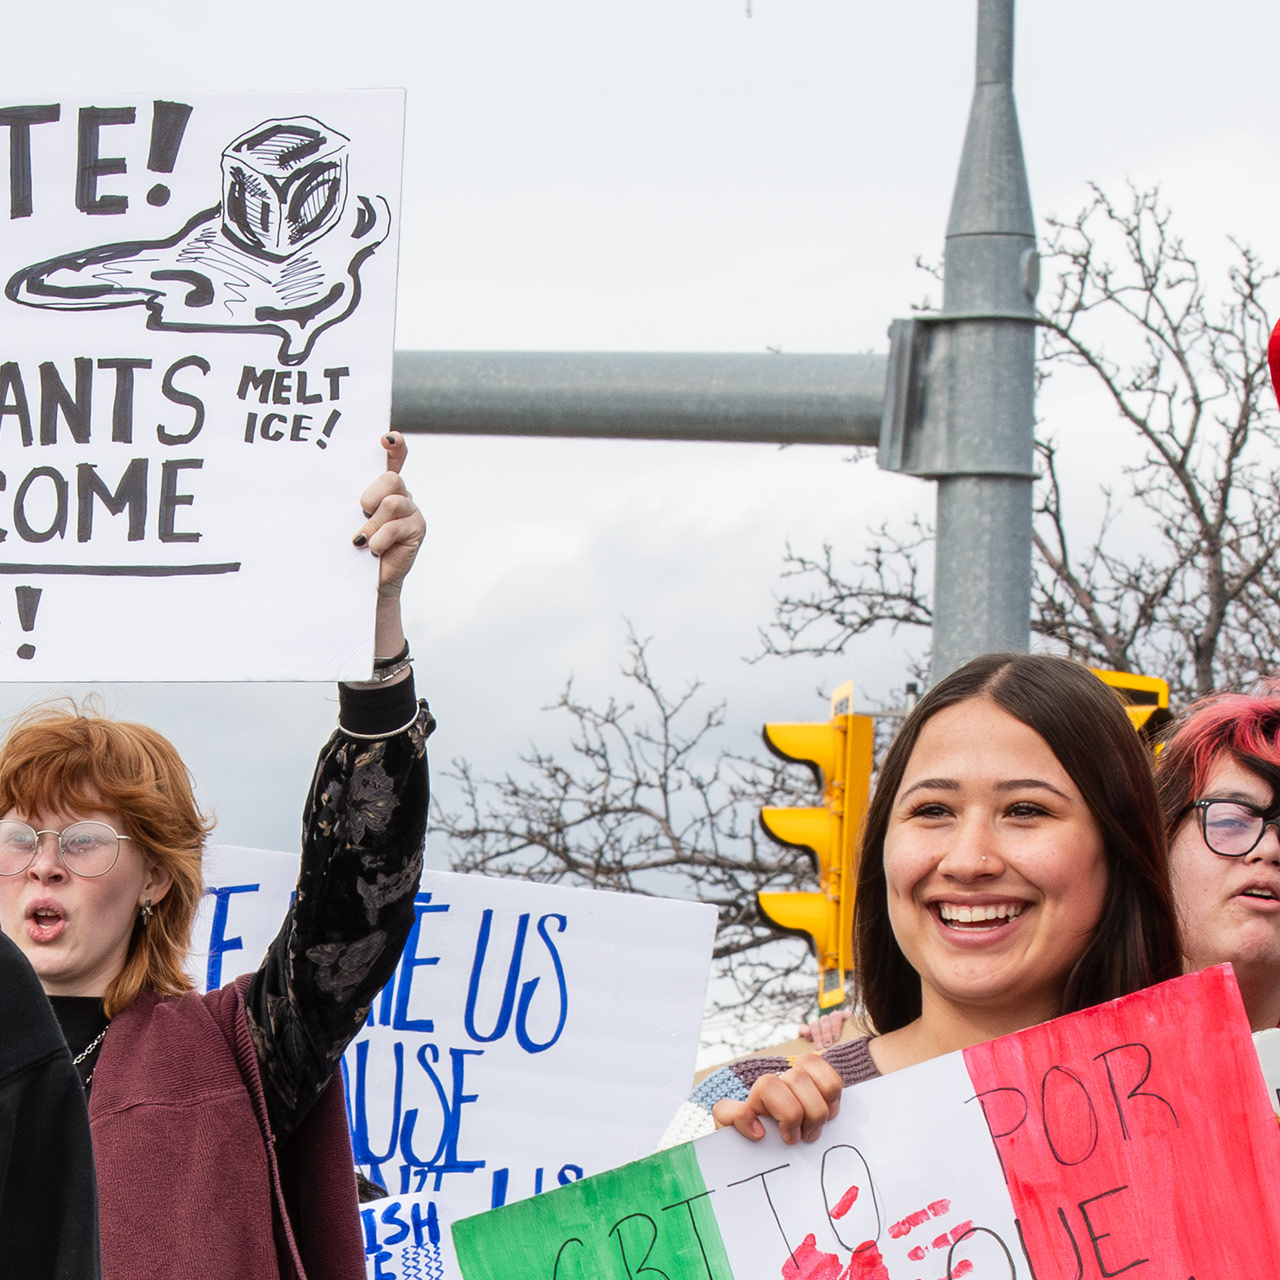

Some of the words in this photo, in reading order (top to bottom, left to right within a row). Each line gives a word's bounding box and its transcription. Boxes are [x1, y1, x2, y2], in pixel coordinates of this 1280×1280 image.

[236, 364, 350, 406] MELT
[244, 408, 342, 450] ICE!
[464, 908, 568, 1054] US
[965, 1042, 1181, 1185] POR
